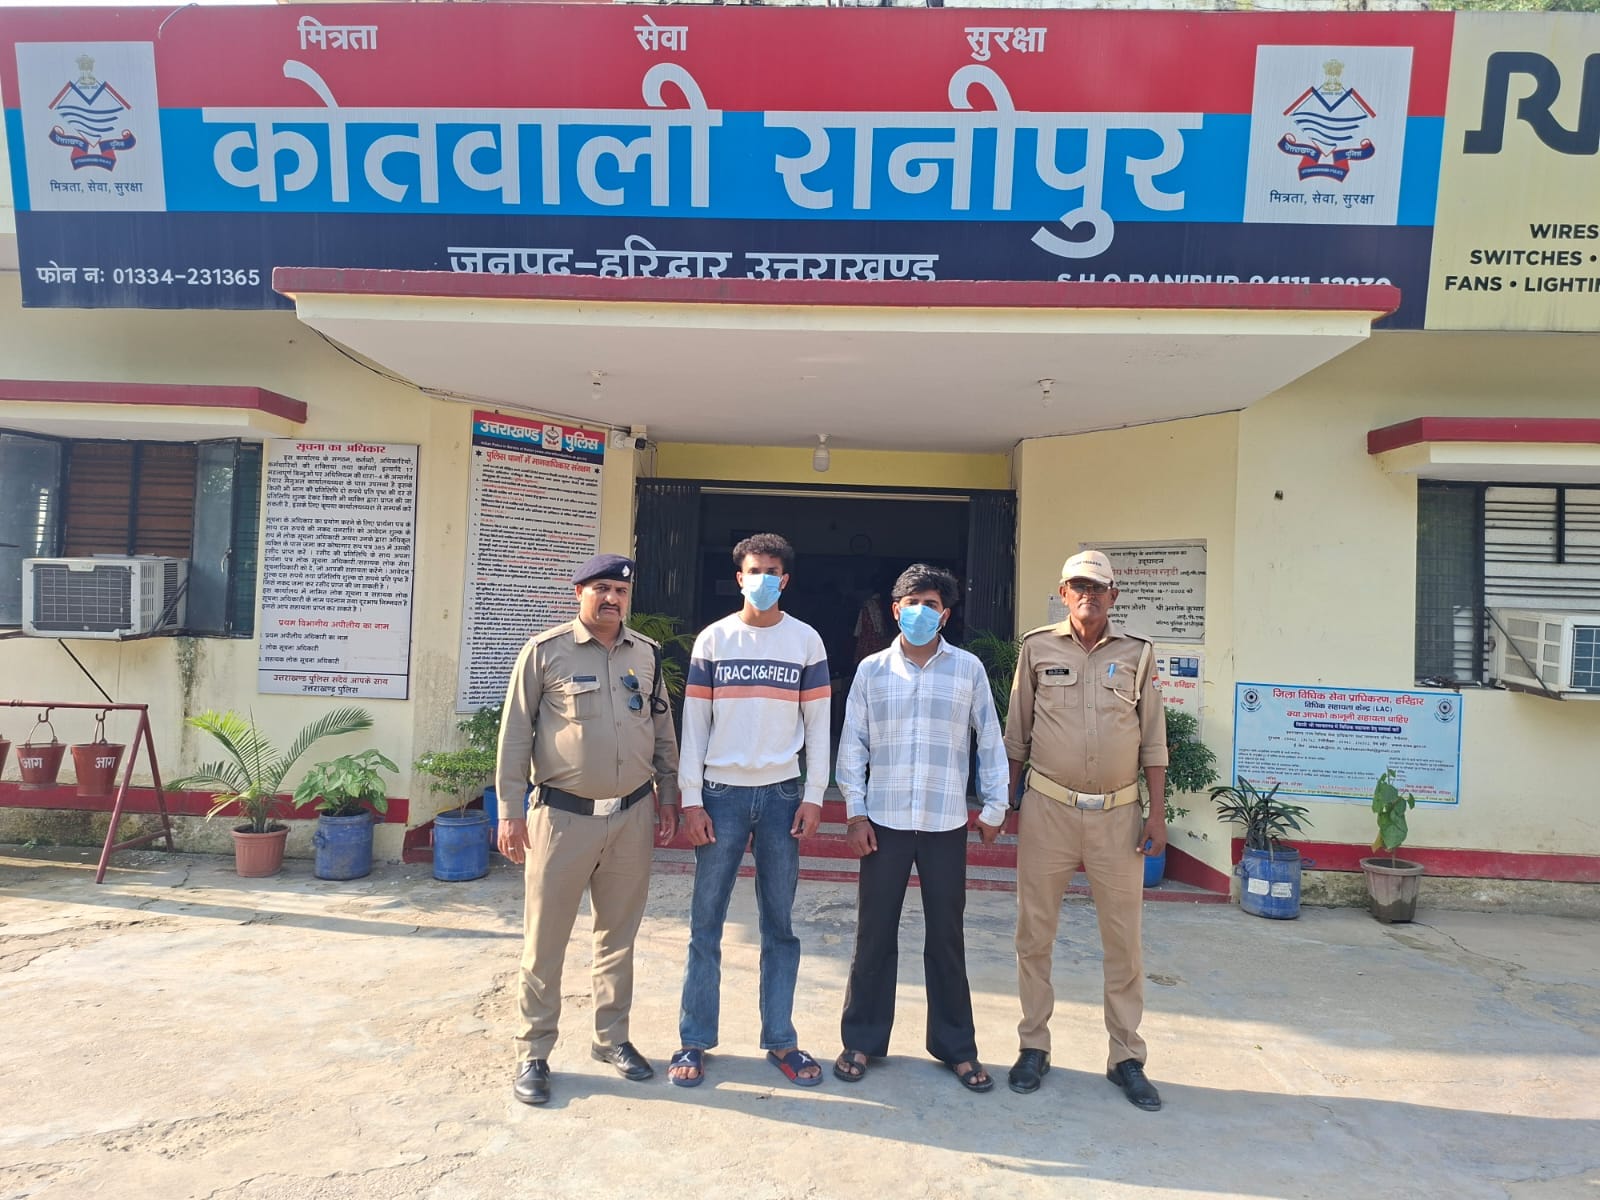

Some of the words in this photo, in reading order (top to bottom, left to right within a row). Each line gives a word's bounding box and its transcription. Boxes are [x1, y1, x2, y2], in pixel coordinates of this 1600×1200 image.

[298, 17, 378, 51] मित्रता
[634, 15, 688, 52] सेवा
[965, 26, 1046, 61] सुरक्षा
[202, 59, 723, 208] कोतवाली
[764, 64, 1204, 258] रानीपुर
[50, 180, 84, 193] मित्रता,
[88, 179, 111, 193] सेवा,
[114, 182, 144, 196] सुरक्षा
[1270, 190, 1307, 205] मित्रता,
[1312, 191, 1338, 205] सेवा,
[1343, 194, 1375, 208] सुरक्षा
[1529, 223, 1599, 240] WIRES
[1469, 249, 1583, 265] SWITCHES
[36, 260, 77, 283] फोन
[113, 267, 260, 286] 01334-231365
[745, 252, 940, 281] उत्तराखण्ड
[1444, 275, 1503, 291] FANS
[480, 420, 540, 442] उत्तराखण्ड
[565, 431, 599, 452] पुलिस
[296, 442, 323, 452] सूचना
[328, 443, 341, 452] का
[346, 444, 385, 454] अधिकार
[486, 450, 506, 462] पुलिस
[273, 673, 306, 684] उत्तराखण्ड
[309, 674, 328, 685] पुलिस
[331, 675, 347, 685] सदैव
[350, 676, 370, 686] आपके
[373, 676, 387, 687] साथ
[716, 664, 800, 684] TRACK&FIELD
[302, 683, 335, 694] उत्तराखण्ड
[338, 684, 358, 695] पुलिस
[1273, 688, 1295, 699] जिला
[1298, 689, 1326, 700] विधिक
[1328, 691, 1346, 701] सेवा
[1395, 694, 1425, 706] हरिद्वार
[1286, 710, 1300, 718] क्या
[1302, 711, 1328, 719] आपको
[1372, 705, 1393, 713] (LAC)
[22, 757, 43, 769] आग
[95, 756, 116, 769] आग
